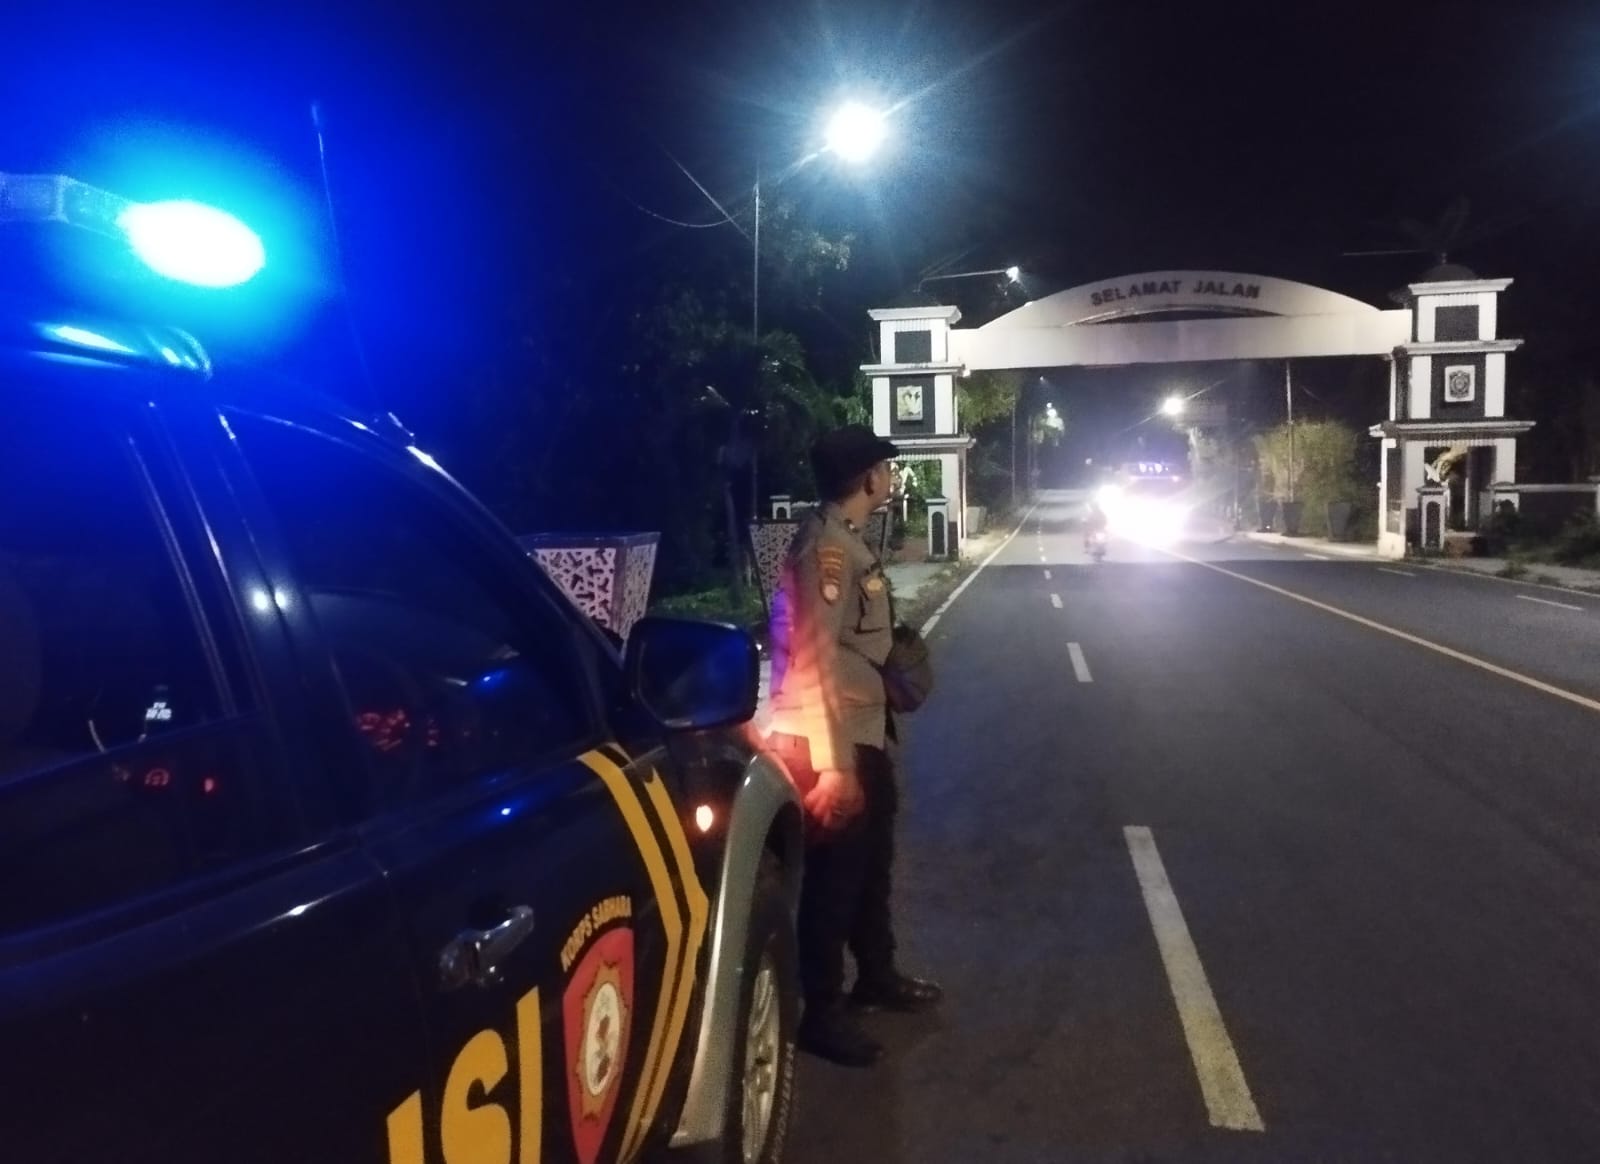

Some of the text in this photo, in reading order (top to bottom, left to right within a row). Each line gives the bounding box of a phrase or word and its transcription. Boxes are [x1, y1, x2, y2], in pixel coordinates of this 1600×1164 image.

[1090, 280, 1262, 306] SELAMAT JALAN
[560, 912, 593, 973] KORPS
